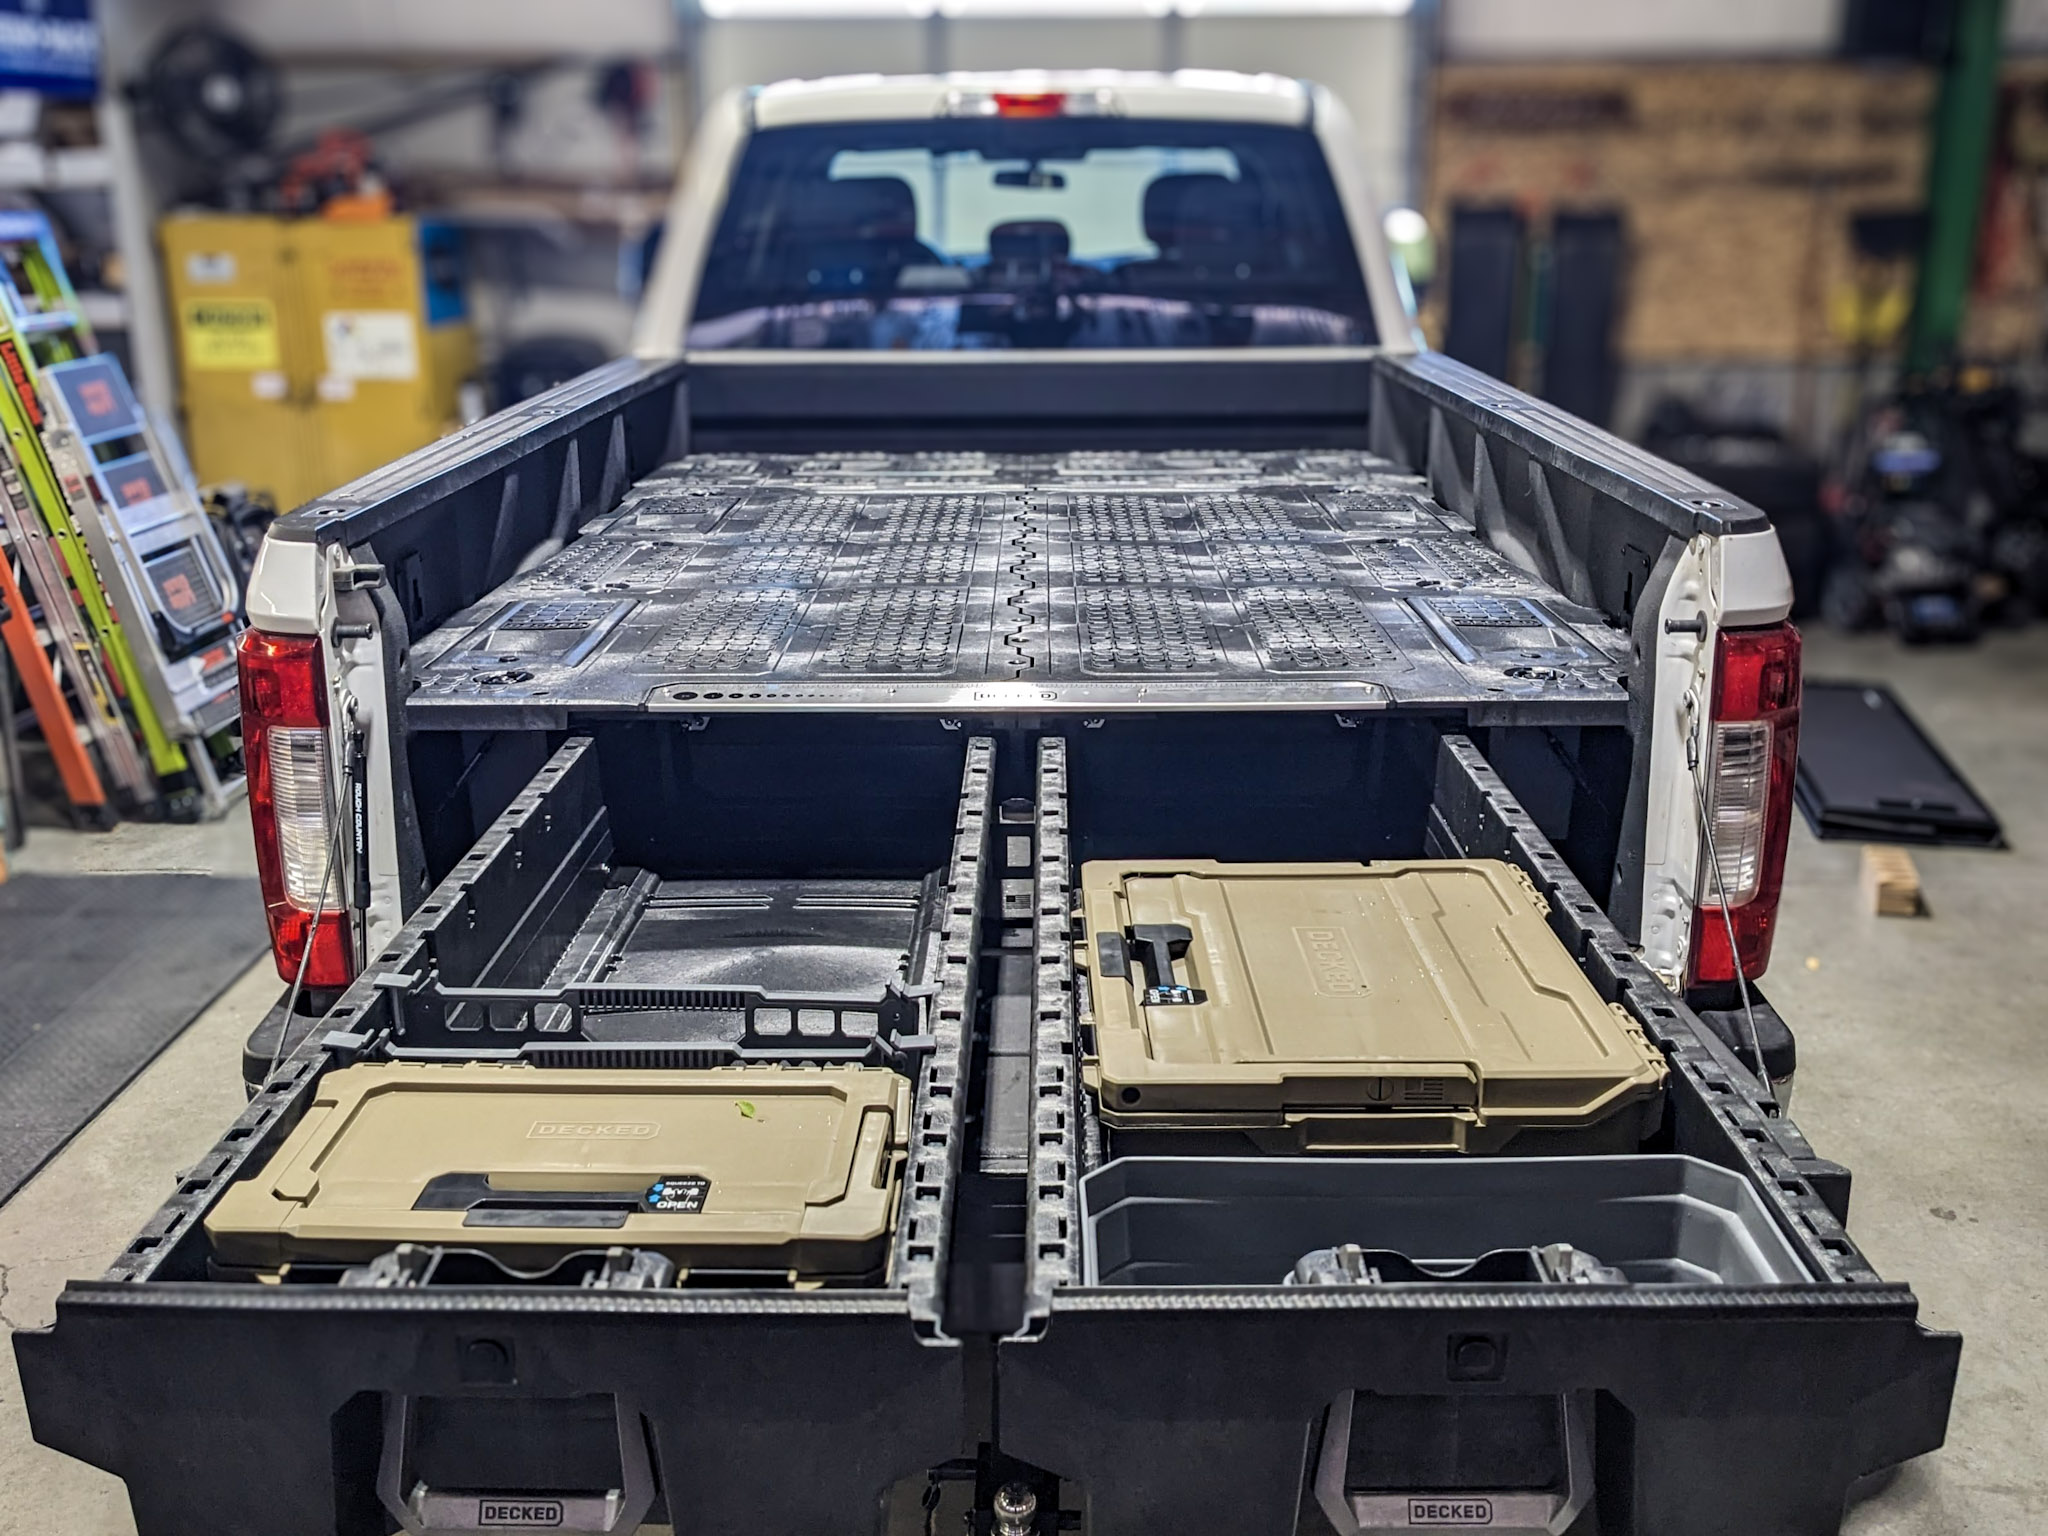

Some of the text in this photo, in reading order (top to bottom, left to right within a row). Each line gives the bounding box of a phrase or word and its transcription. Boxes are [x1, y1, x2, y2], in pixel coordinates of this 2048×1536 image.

[354, 783, 363, 854] ROUGH COUNTRY
[1308, 929, 1358, 995] DECKED
[538, 1123, 651, 1136] DECKED
[656, 1200, 699, 1209] OPEN
[484, 1506, 558, 1520] DECKED
[1413, 1505, 1487, 1518] DECKED
